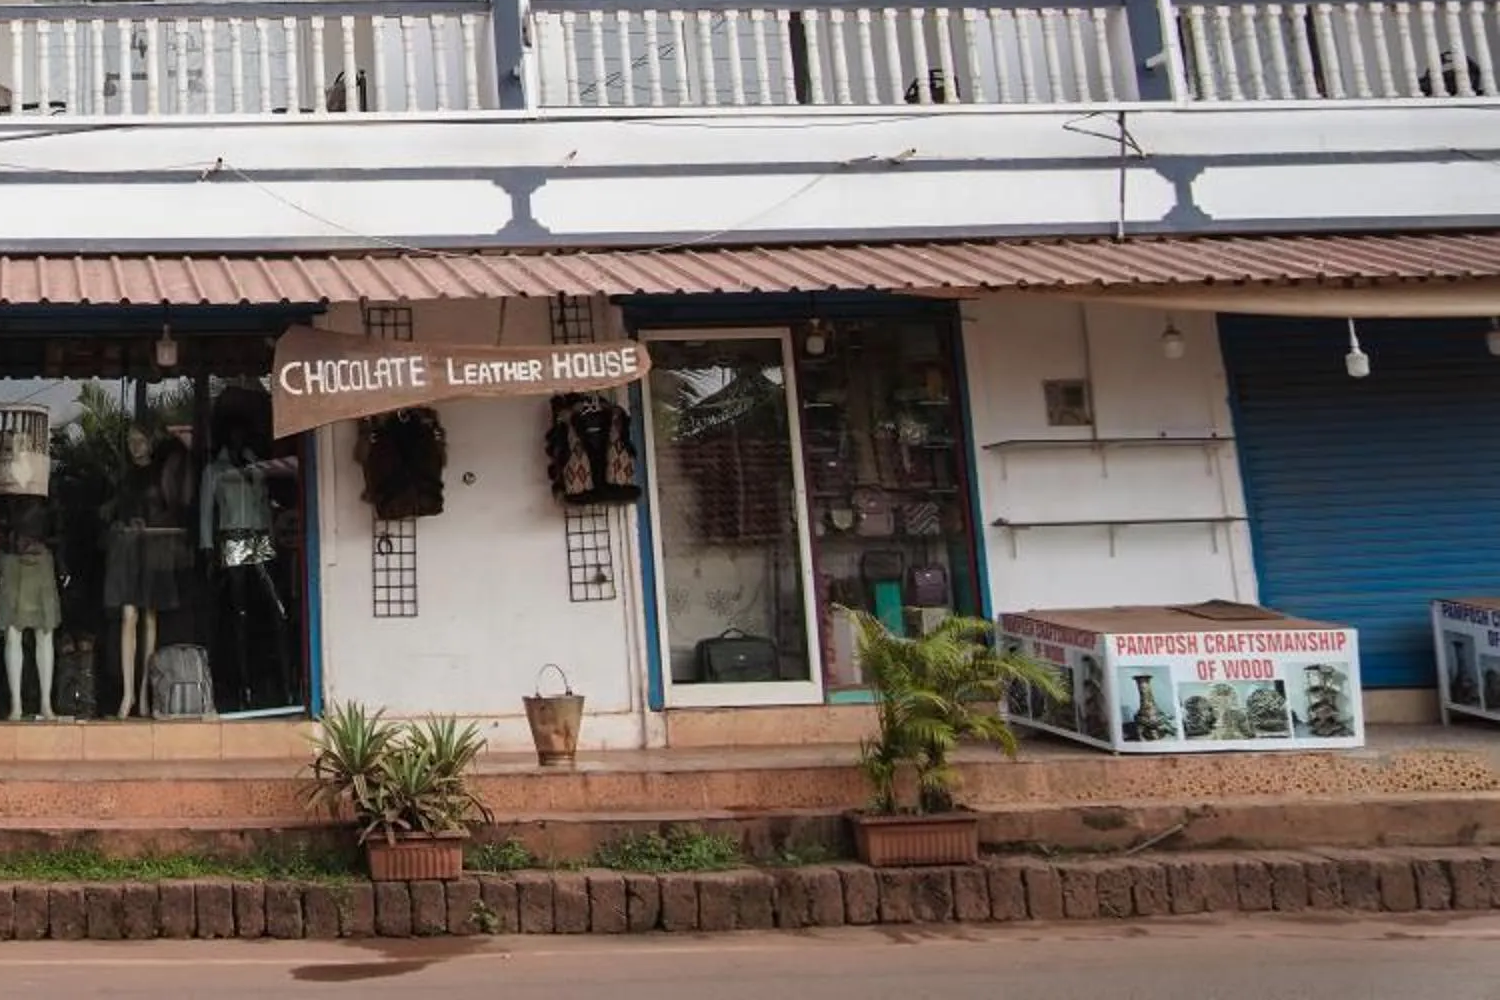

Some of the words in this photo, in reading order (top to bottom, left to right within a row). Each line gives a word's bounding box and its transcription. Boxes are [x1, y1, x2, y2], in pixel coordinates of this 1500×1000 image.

[279, 355, 427, 396] CHOCOLATE
[551, 347, 637, 380] HOUSE
[1115, 634, 1199, 656] PAMPOSH
[1203, 631, 1347, 654] CRAFTSMANSHIP
[1196, 660, 1218, 681] OF
[1223, 658, 1274, 680] WOOD
